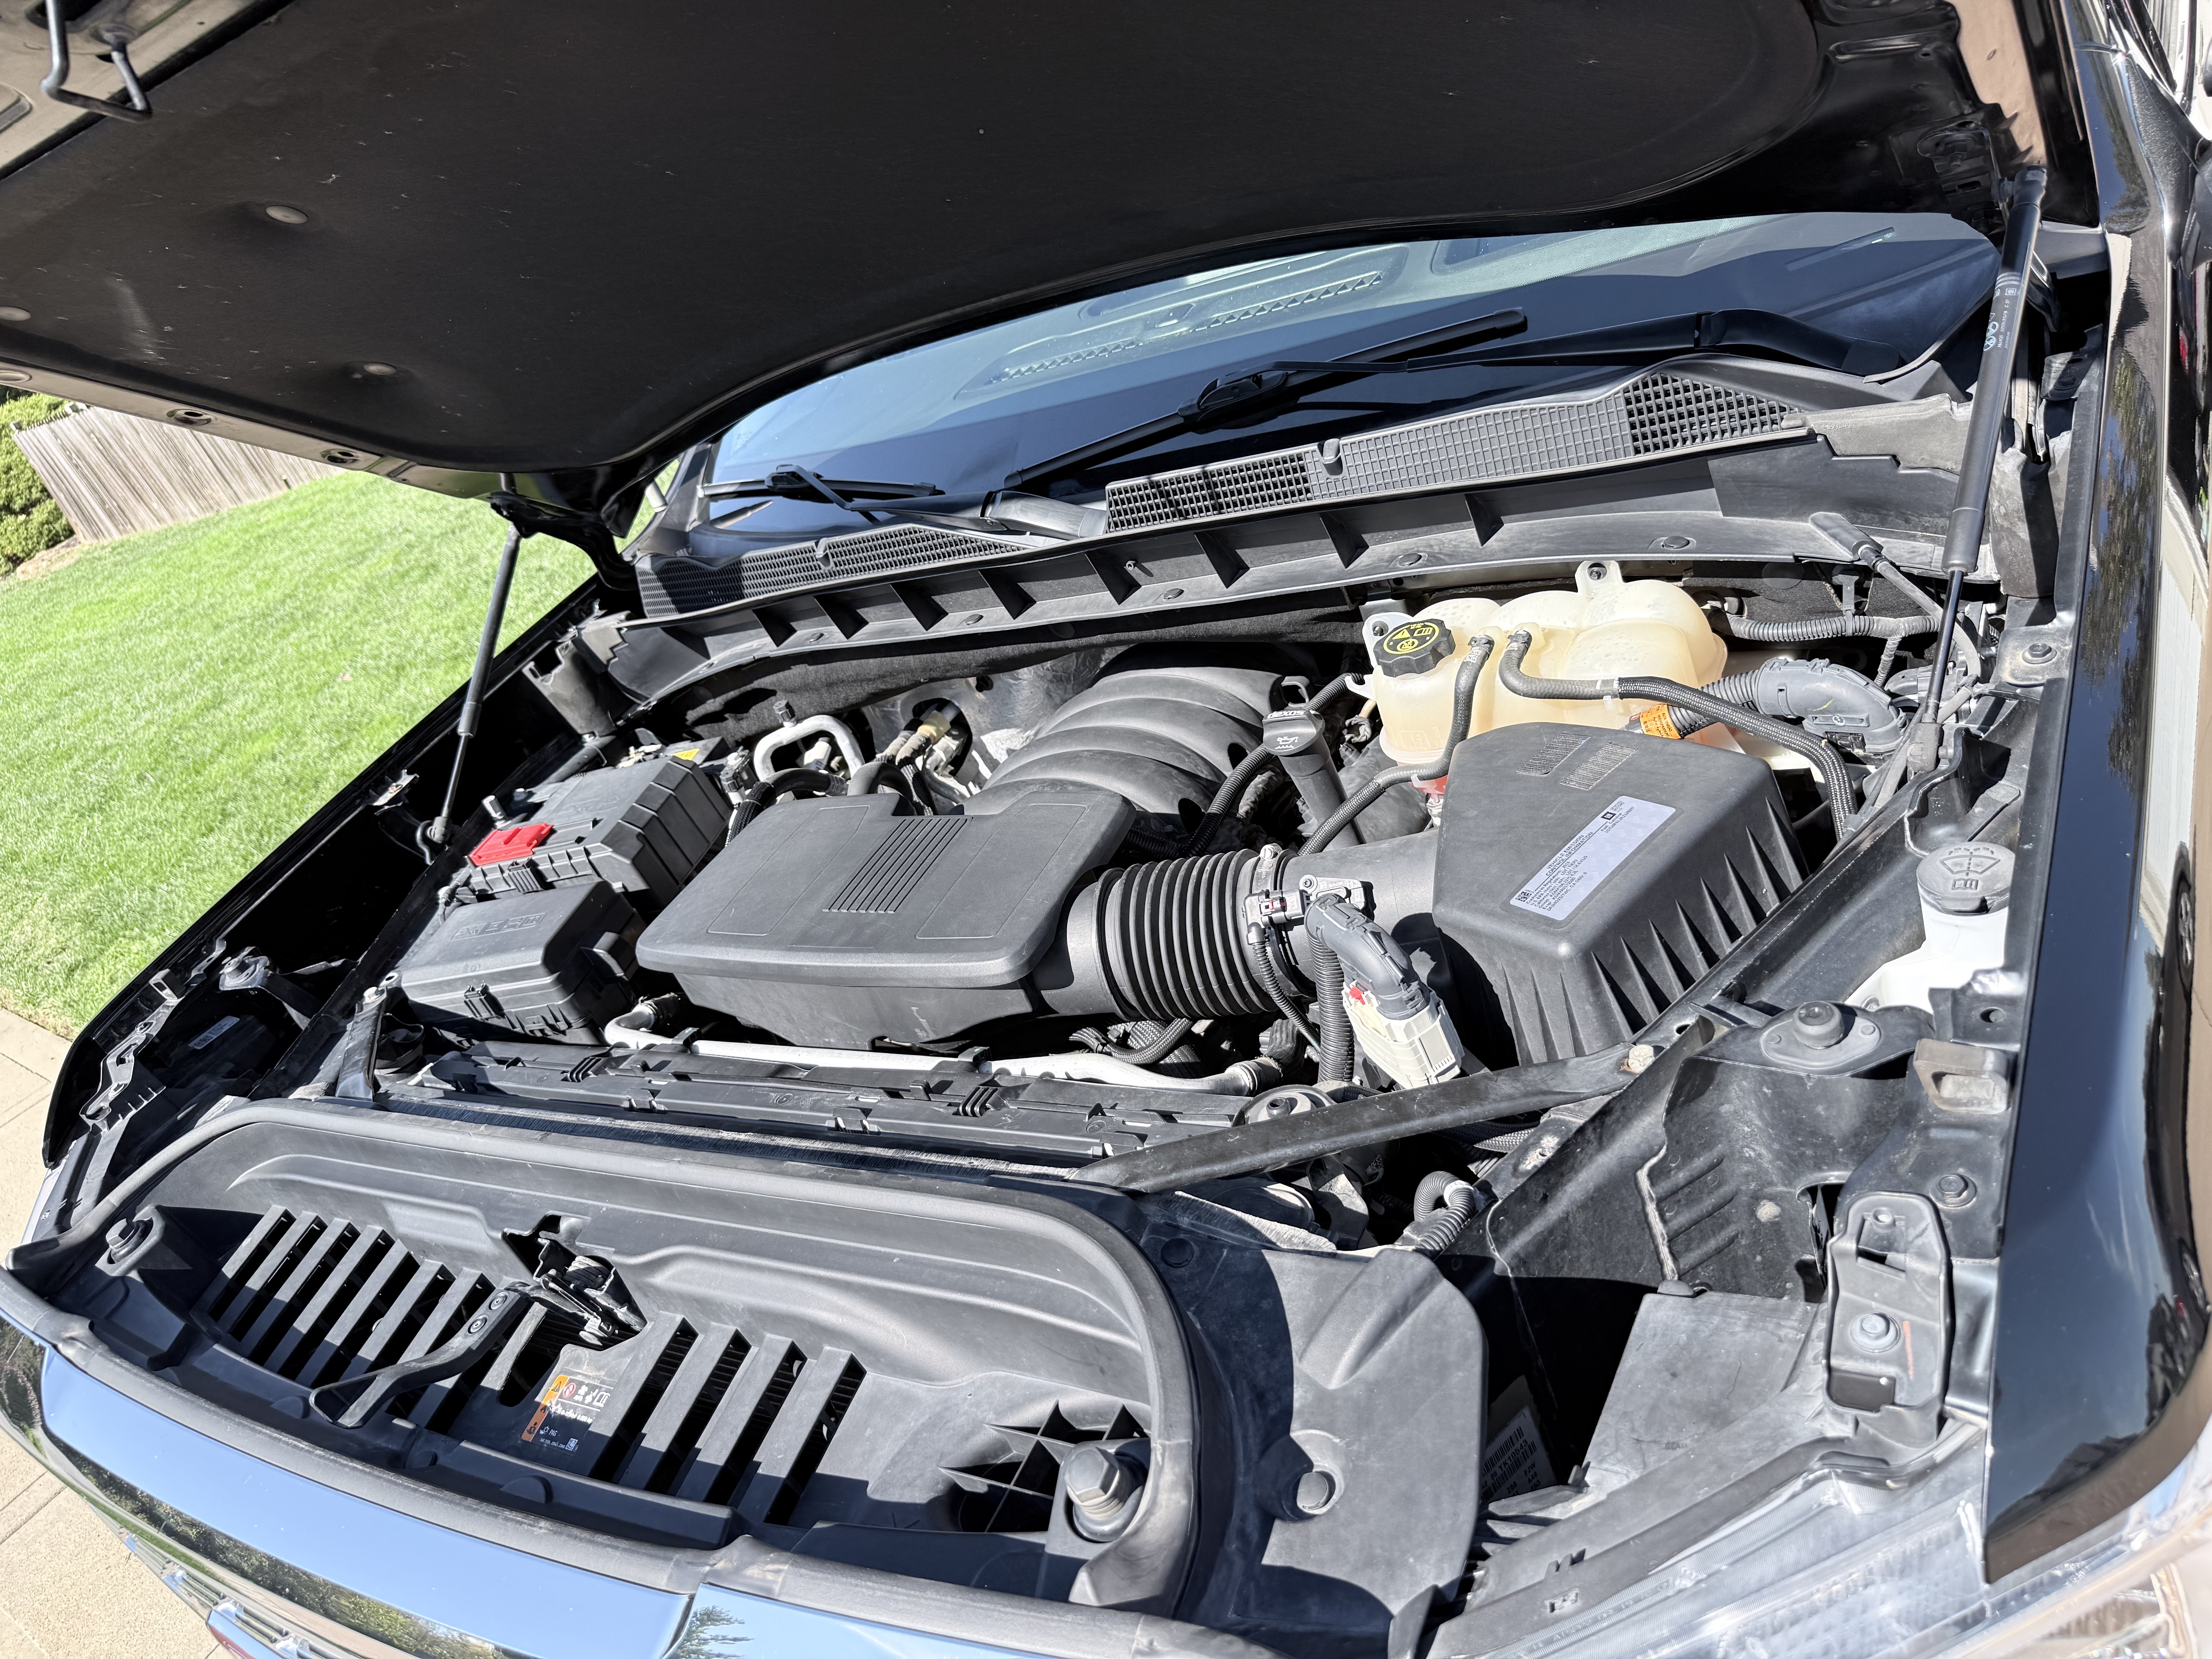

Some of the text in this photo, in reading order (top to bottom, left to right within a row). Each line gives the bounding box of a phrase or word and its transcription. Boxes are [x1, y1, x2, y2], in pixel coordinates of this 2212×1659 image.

[1267, 710, 1307, 719] dexos
[1545, 831, 1594, 876] CONTROL INFORMATION
[1546, 835, 1584, 869] VEHICLE EMISSION
